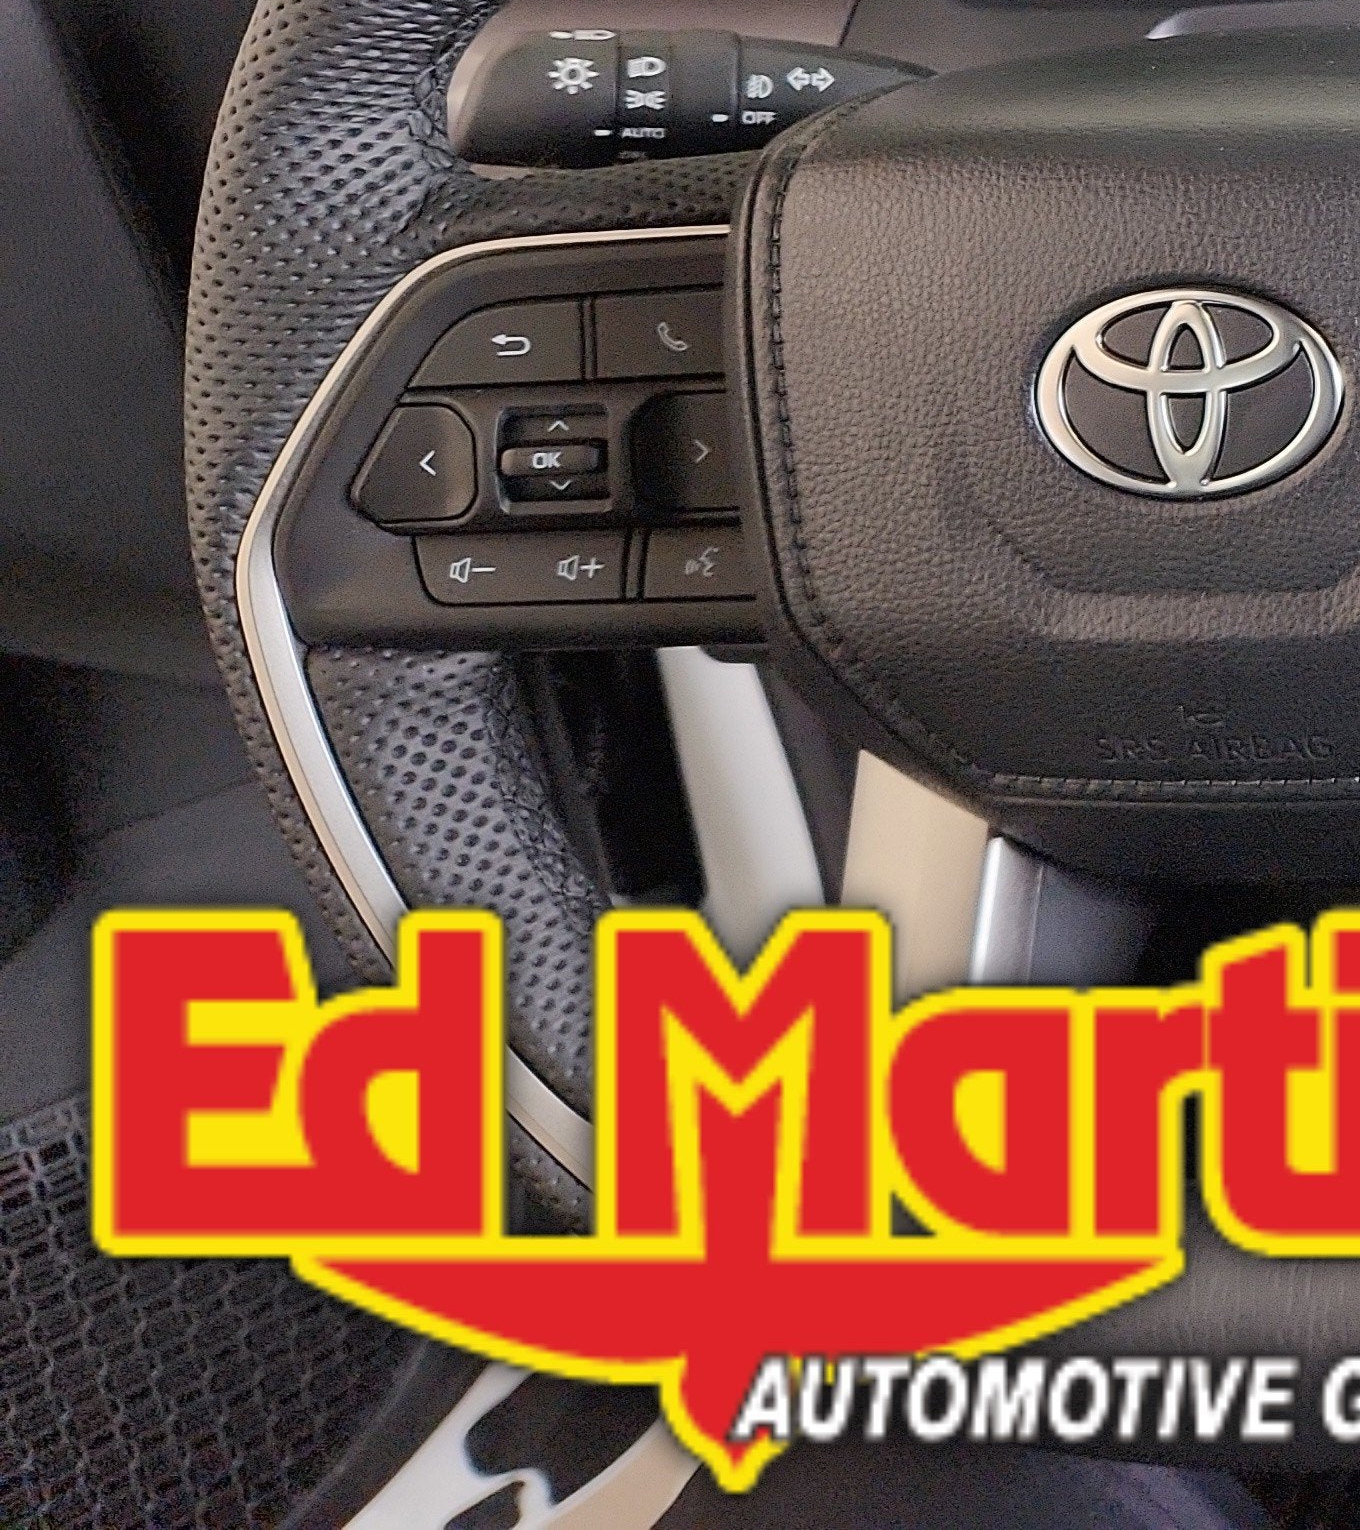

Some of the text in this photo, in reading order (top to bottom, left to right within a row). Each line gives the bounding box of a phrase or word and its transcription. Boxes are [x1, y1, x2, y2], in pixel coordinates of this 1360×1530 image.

[741, 110, 778, 126] OFF
[621, 127, 666, 140] AUTO
[531, 451, 562, 469] OK
